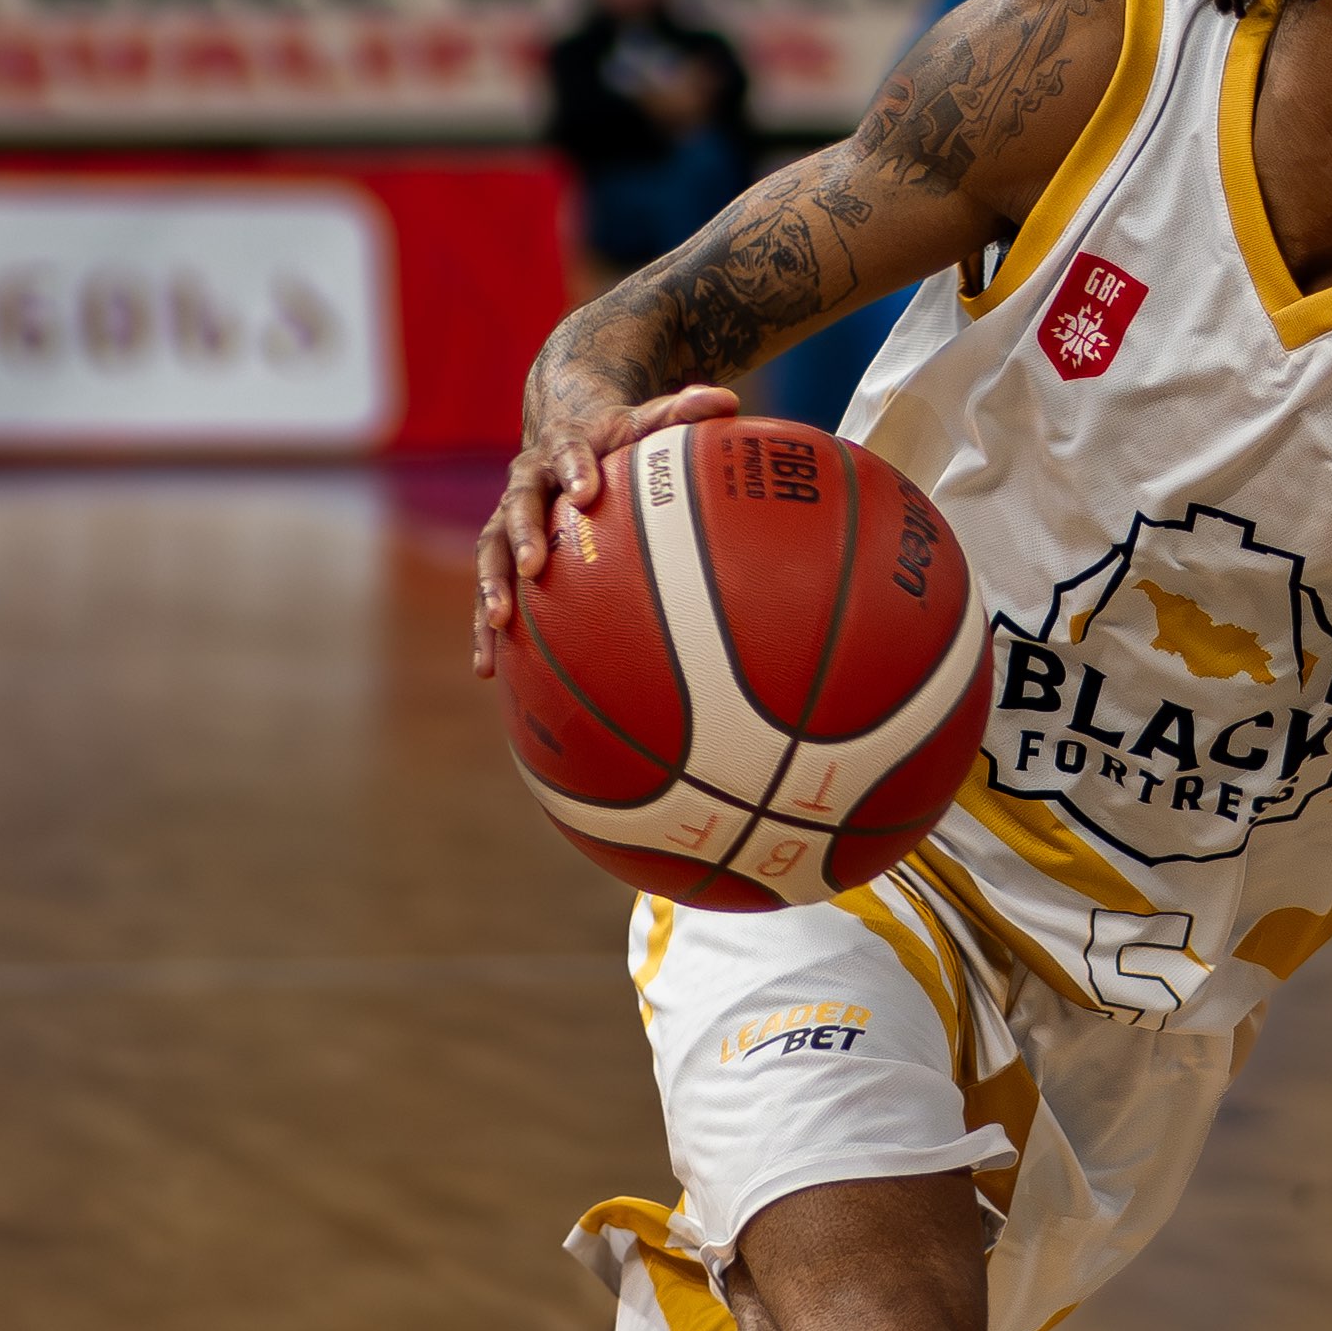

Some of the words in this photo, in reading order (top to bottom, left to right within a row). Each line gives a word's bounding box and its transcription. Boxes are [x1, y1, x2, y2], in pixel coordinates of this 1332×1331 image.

[1084, 267, 1126, 307] GBF
[768, 437, 822, 504] FIBA
[720, 1001, 873, 1064] LEADER
[742, 1024, 866, 1062] BET
